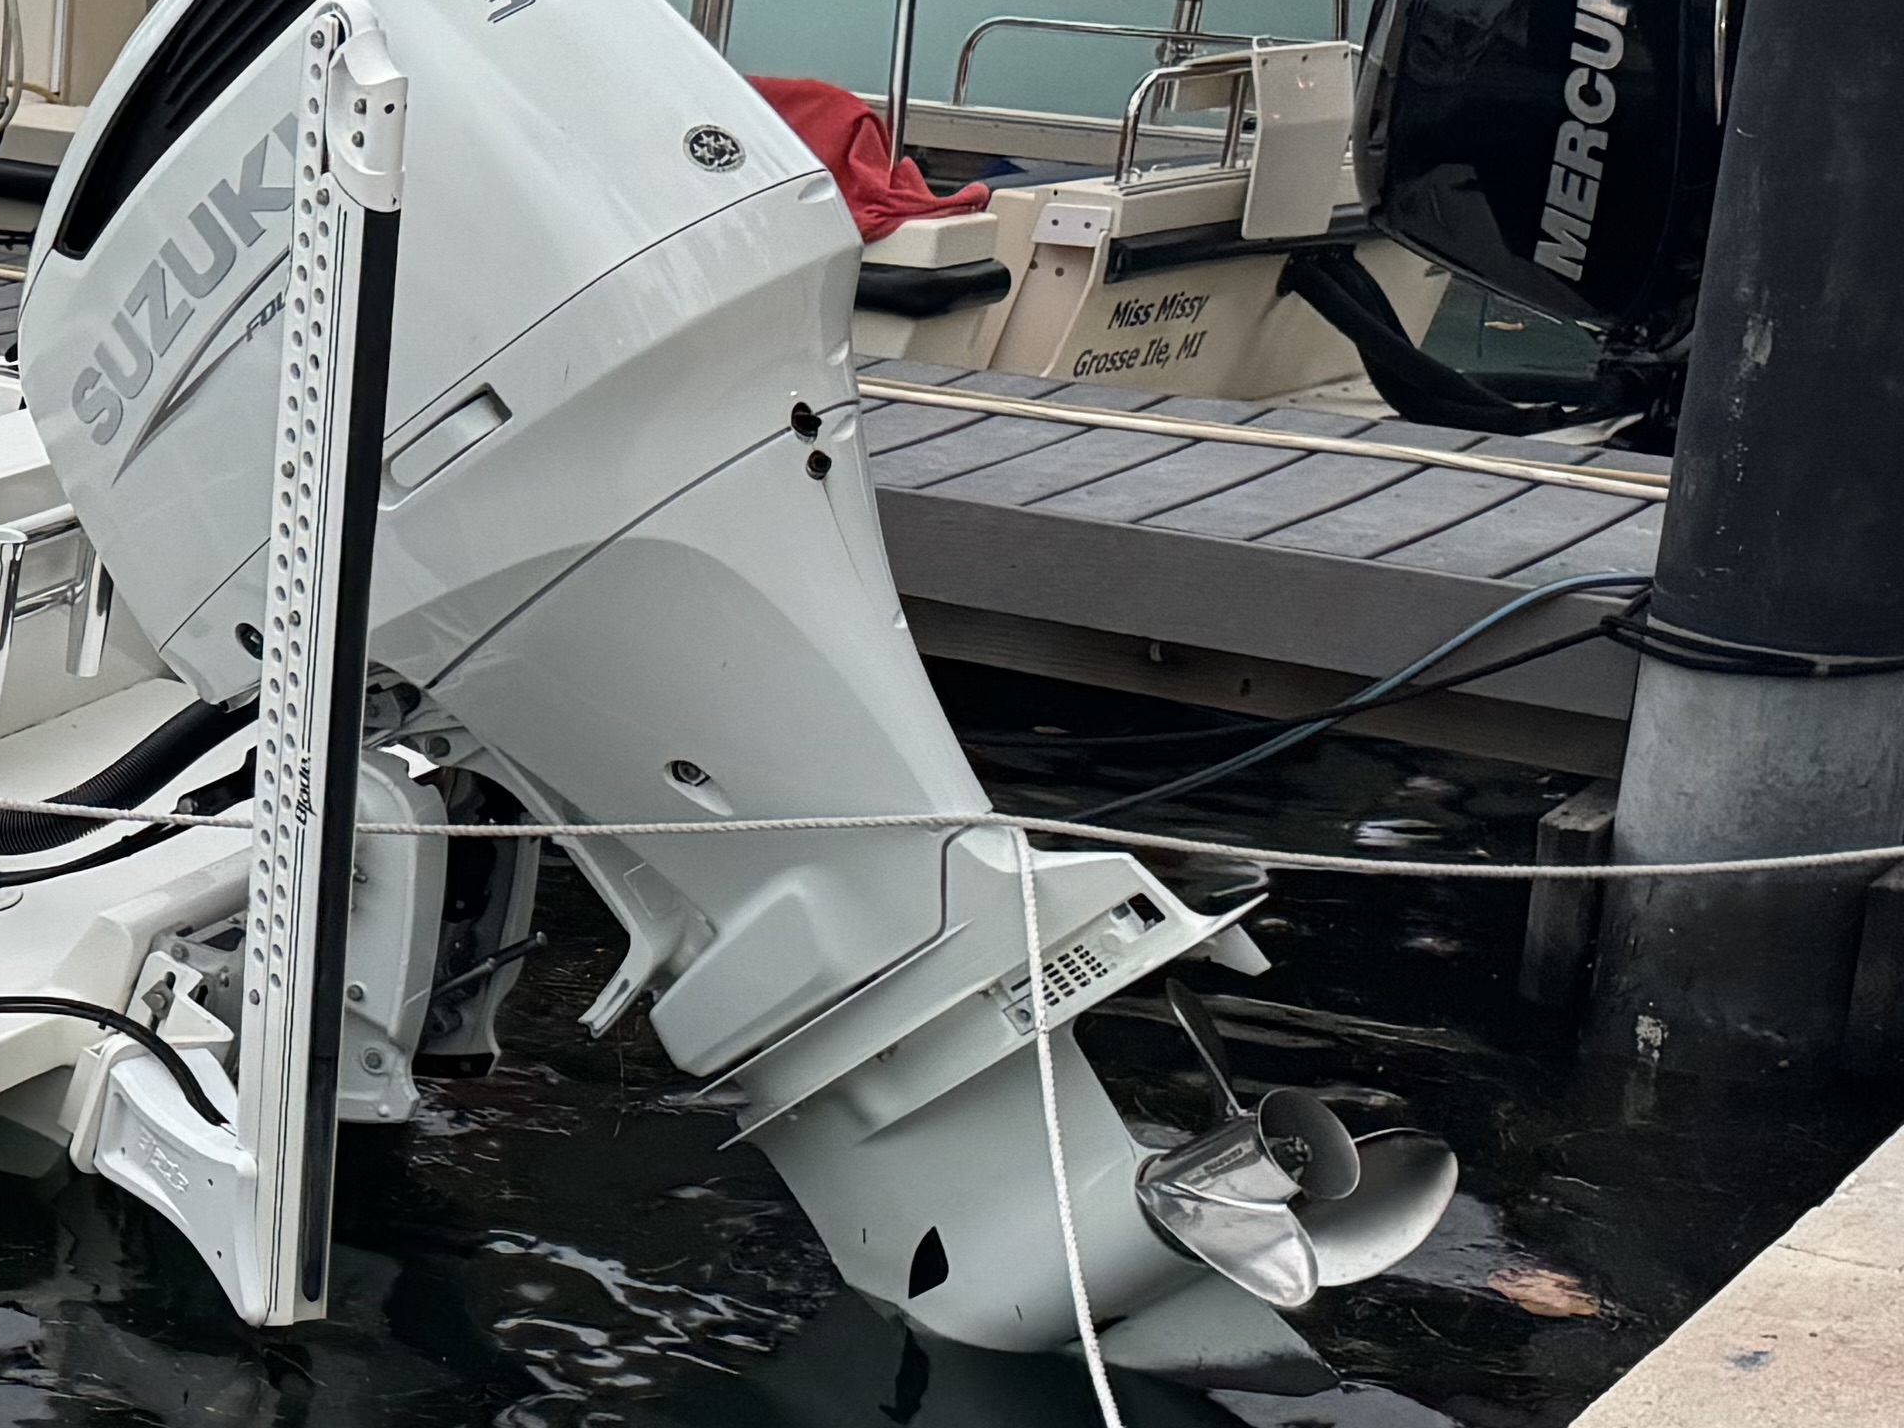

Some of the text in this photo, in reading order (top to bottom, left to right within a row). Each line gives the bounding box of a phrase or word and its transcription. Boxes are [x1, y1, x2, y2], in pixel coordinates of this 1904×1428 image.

[1107, 291, 1211, 330] Miss Missy
[1073, 329, 1208, 378] Grosse Ile, MI
